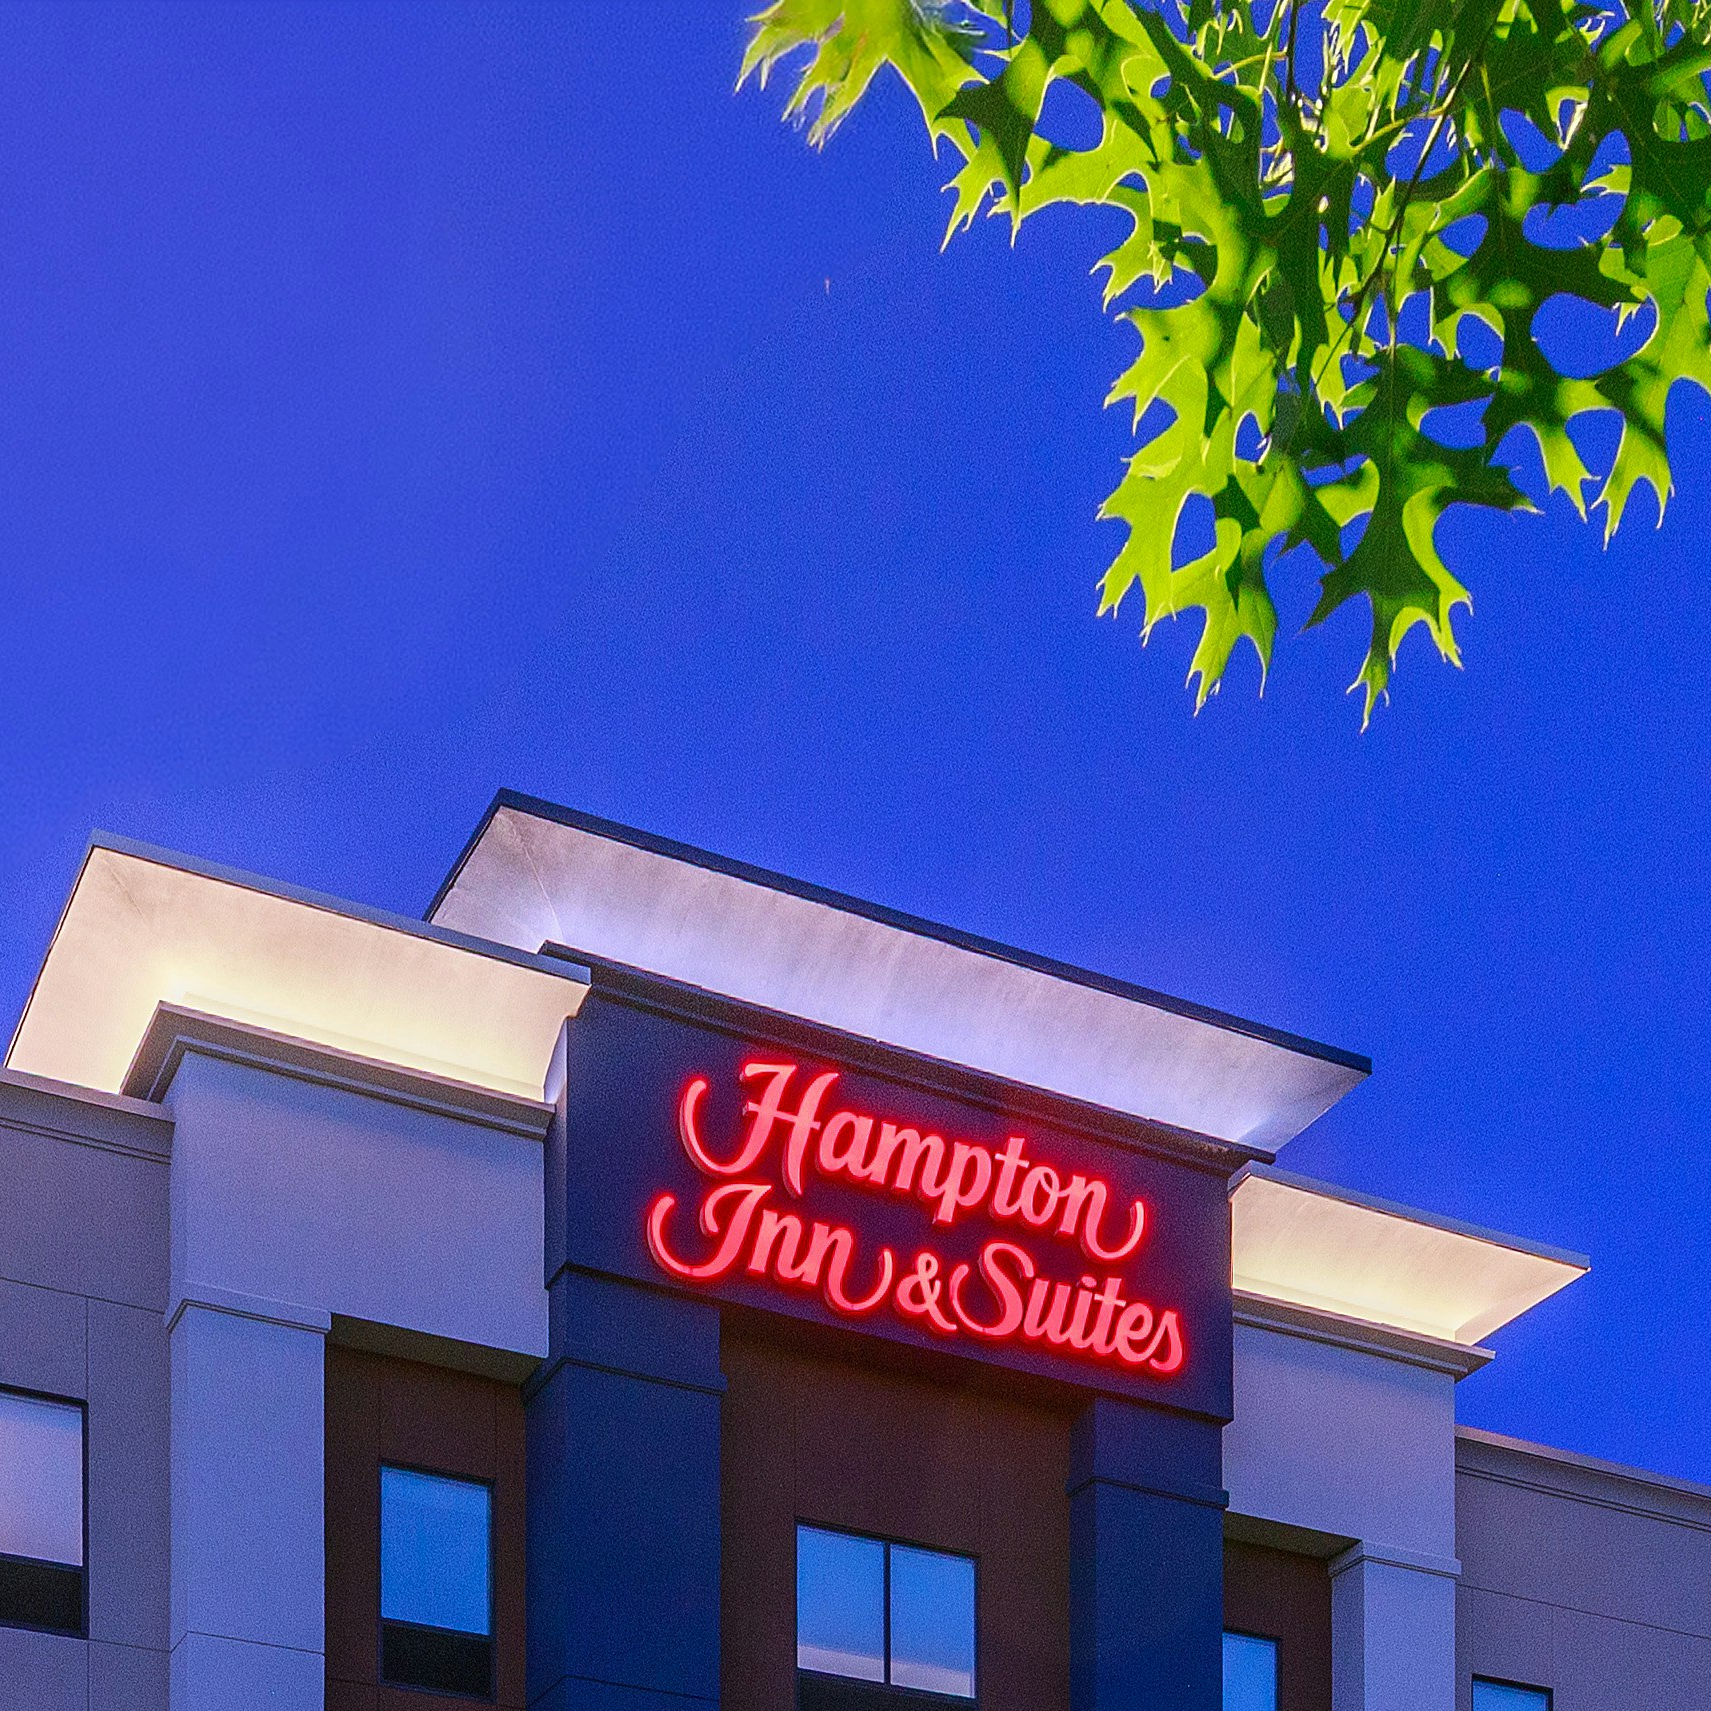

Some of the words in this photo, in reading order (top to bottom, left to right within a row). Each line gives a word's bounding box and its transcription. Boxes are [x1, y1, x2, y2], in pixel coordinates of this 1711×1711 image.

[680, 1062, 1145, 1262] Hampton
[648, 1183, 893, 1314] Inn
[896, 1252, 958, 1332] &
[951, 1241, 1184, 1374] Suites
